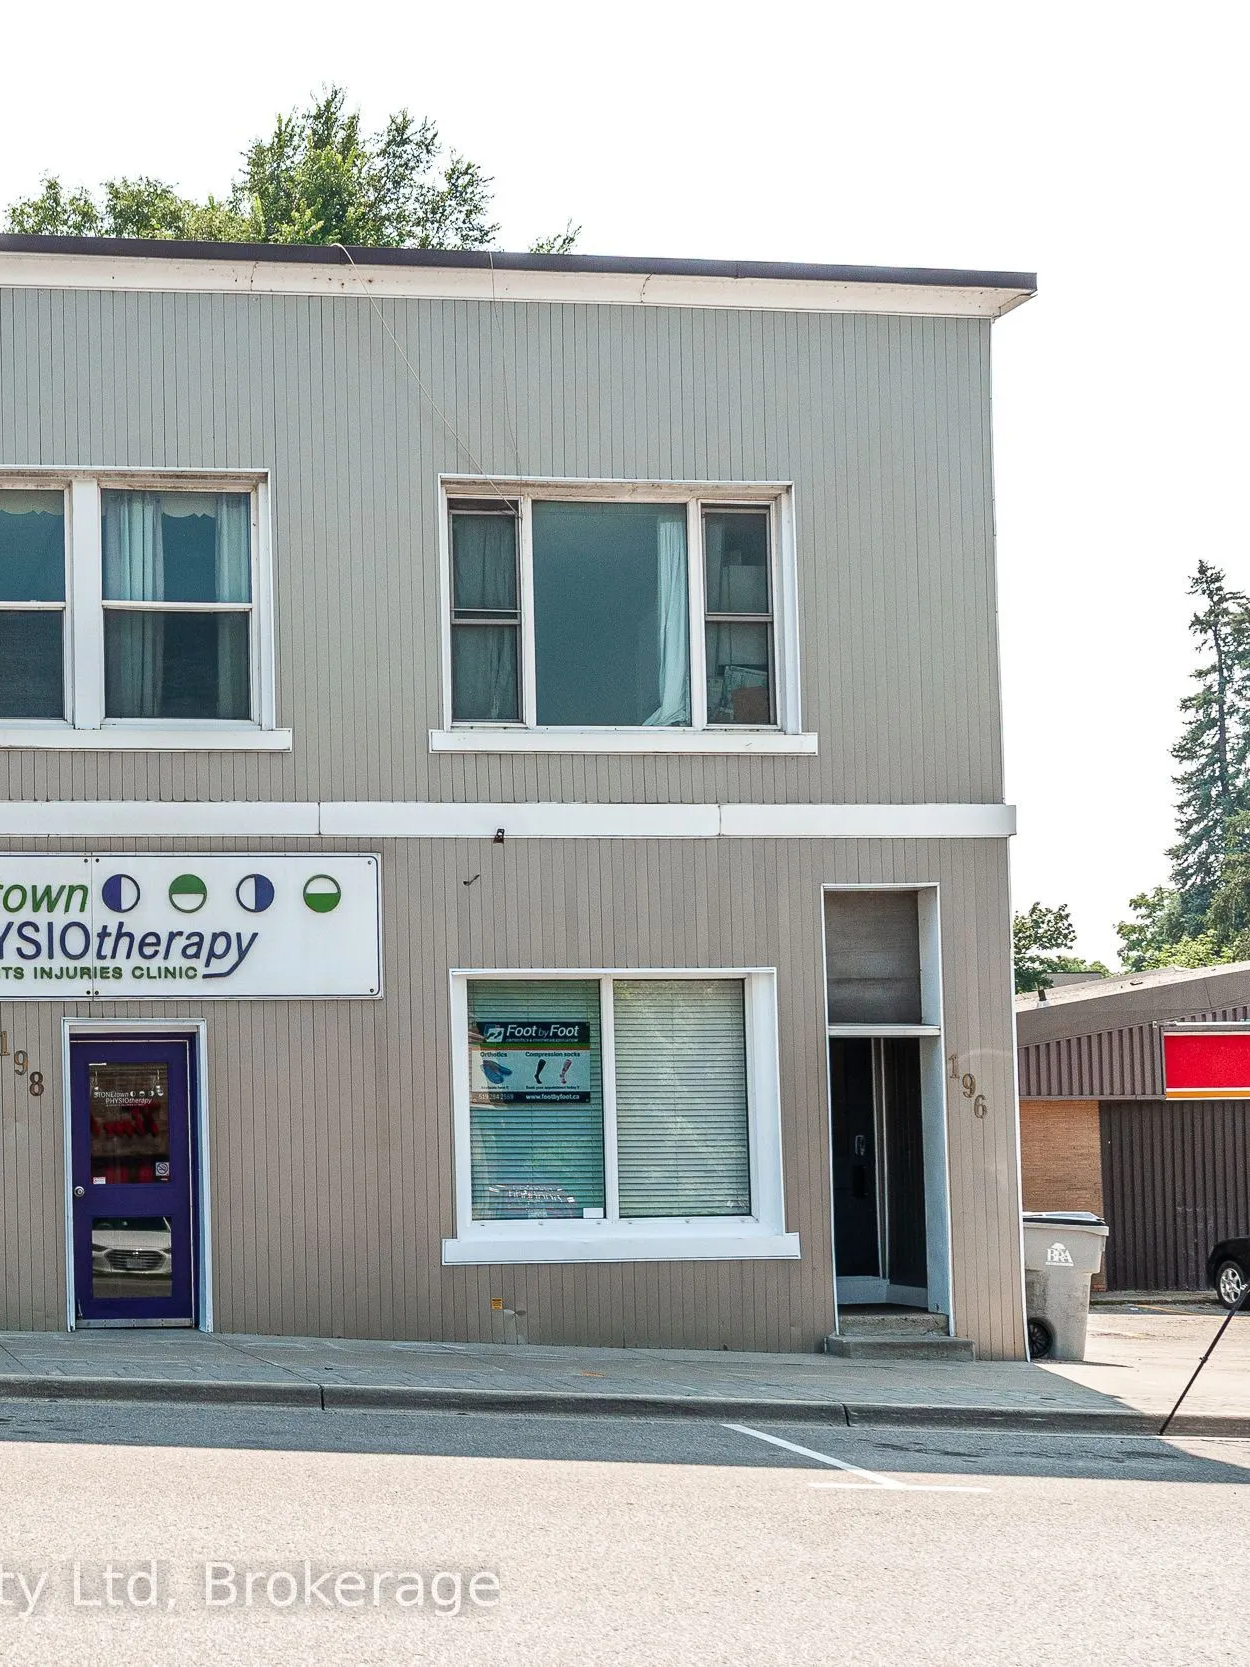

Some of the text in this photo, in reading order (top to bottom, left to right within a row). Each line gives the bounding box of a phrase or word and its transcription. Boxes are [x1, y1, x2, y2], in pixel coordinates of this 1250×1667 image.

[33, 966, 123, 980] INJURIES
[132, 966, 198, 979] CLINIC
[506, 1024, 579, 1039] Foot by Foot
[948, 1053, 988, 1119] 196
[525, 1093, 580, 1101] www.footbyfoot.ca
